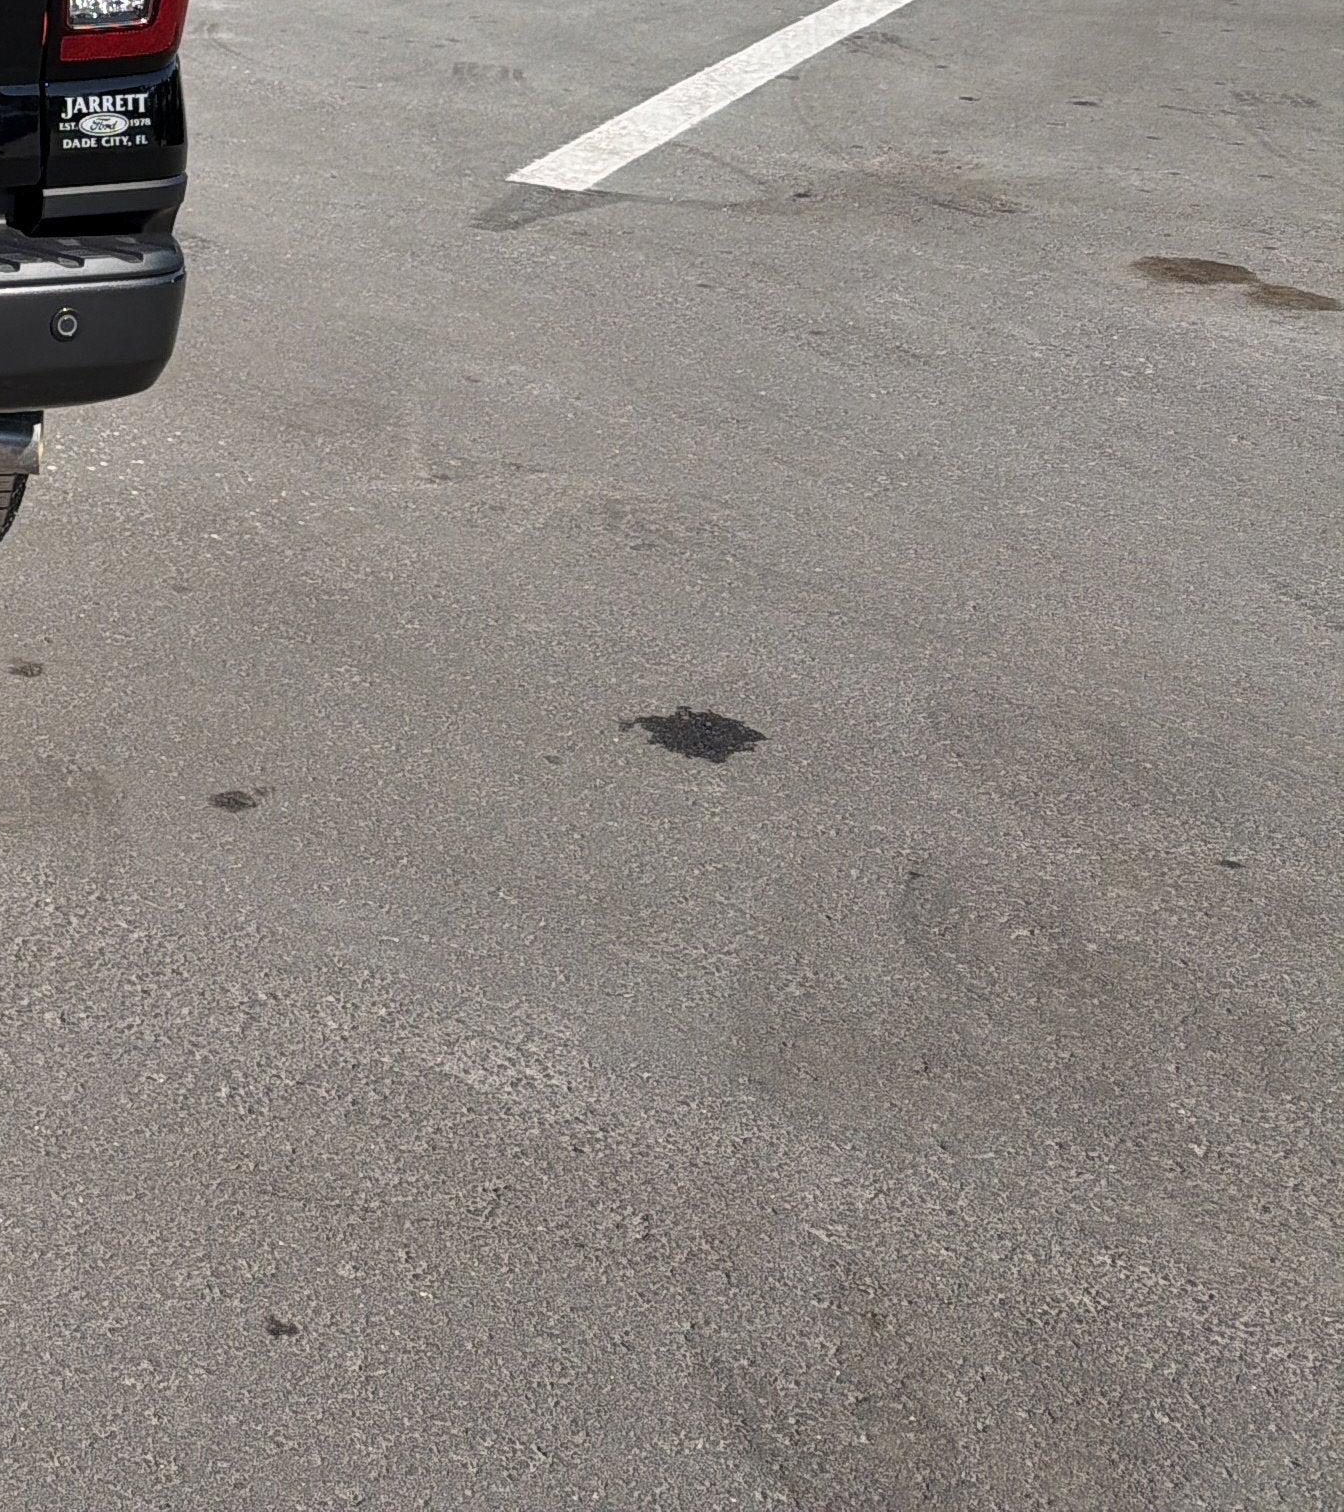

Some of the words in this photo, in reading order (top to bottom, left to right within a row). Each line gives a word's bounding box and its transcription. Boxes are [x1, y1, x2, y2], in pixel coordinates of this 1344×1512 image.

[61, 93, 150, 119] JARRETT
[59, 122, 79, 131] EST.
[89, 117, 118, 132] Ford
[129, 117, 152, 127] 1978
[62, 138, 98, 149] DADE
[101, 136, 132, 148] CITY,
[135, 135, 149, 145] FL
